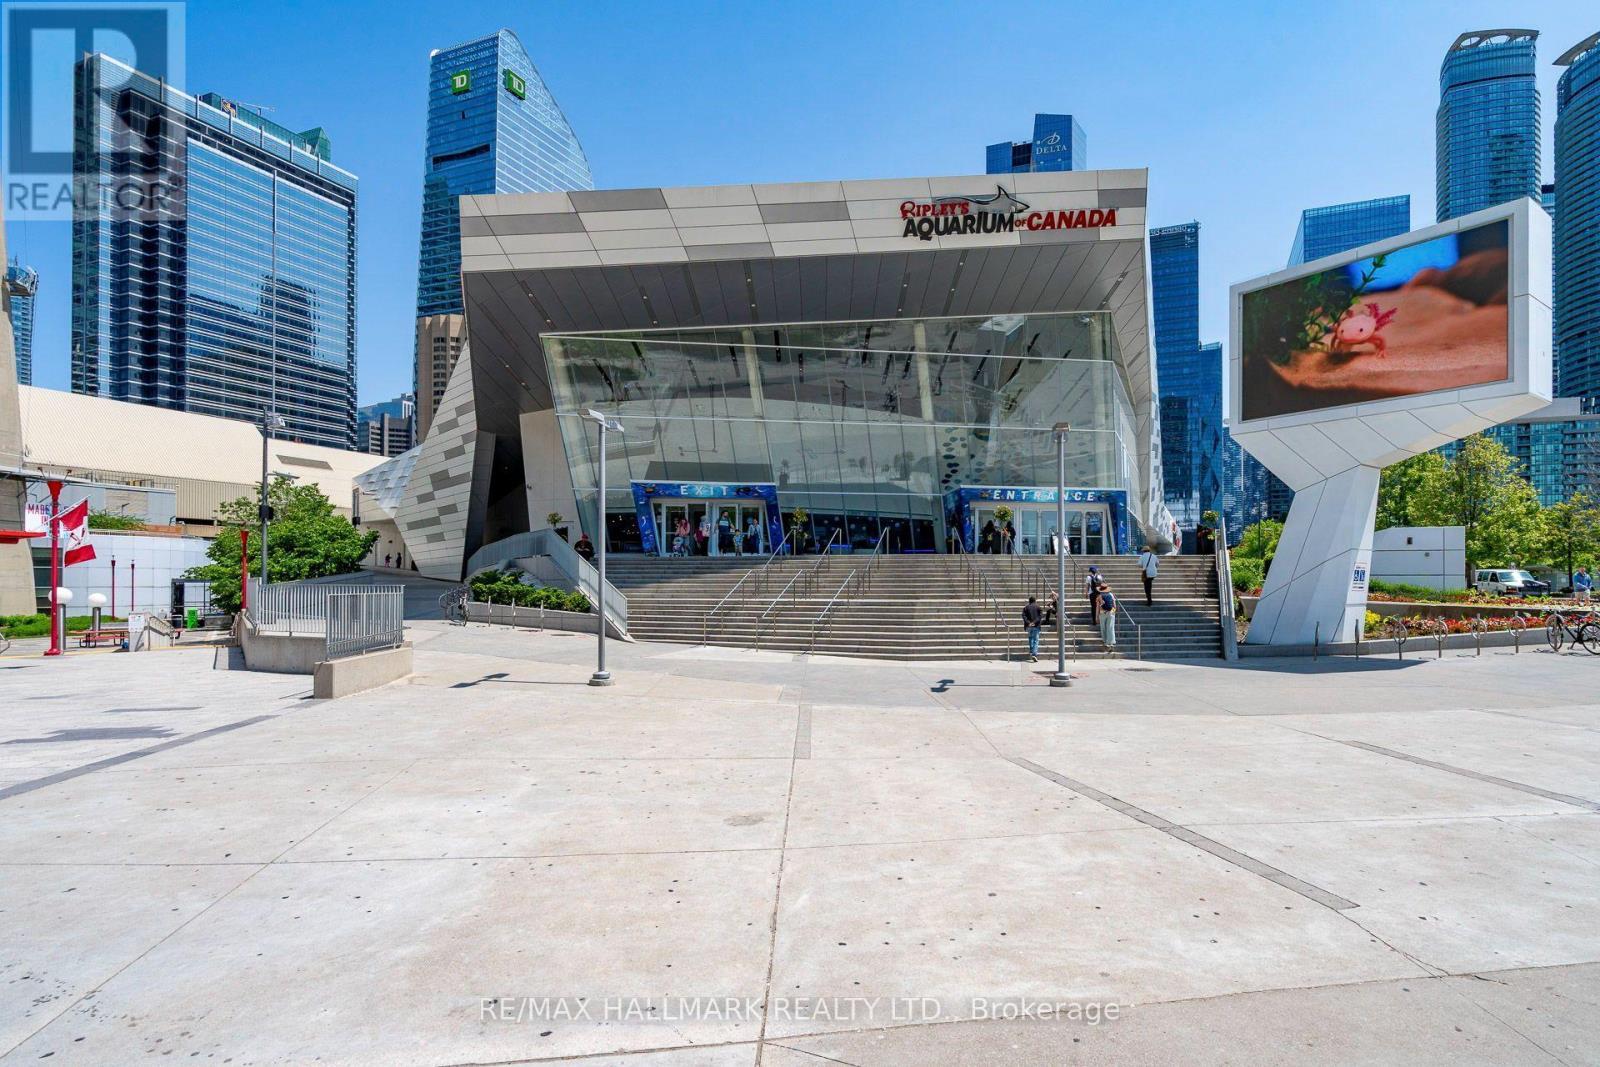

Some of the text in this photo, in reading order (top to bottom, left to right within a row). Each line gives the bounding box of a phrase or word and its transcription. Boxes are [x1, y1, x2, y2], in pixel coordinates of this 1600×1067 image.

[453, 75, 467, 88] TD
[510, 74, 524, 93] TD
[1036, 145, 1067, 155] DELTA
[903, 209, 1117, 241] AQUARIUM OF CANADA
[680, 485, 728, 496] EXIT
